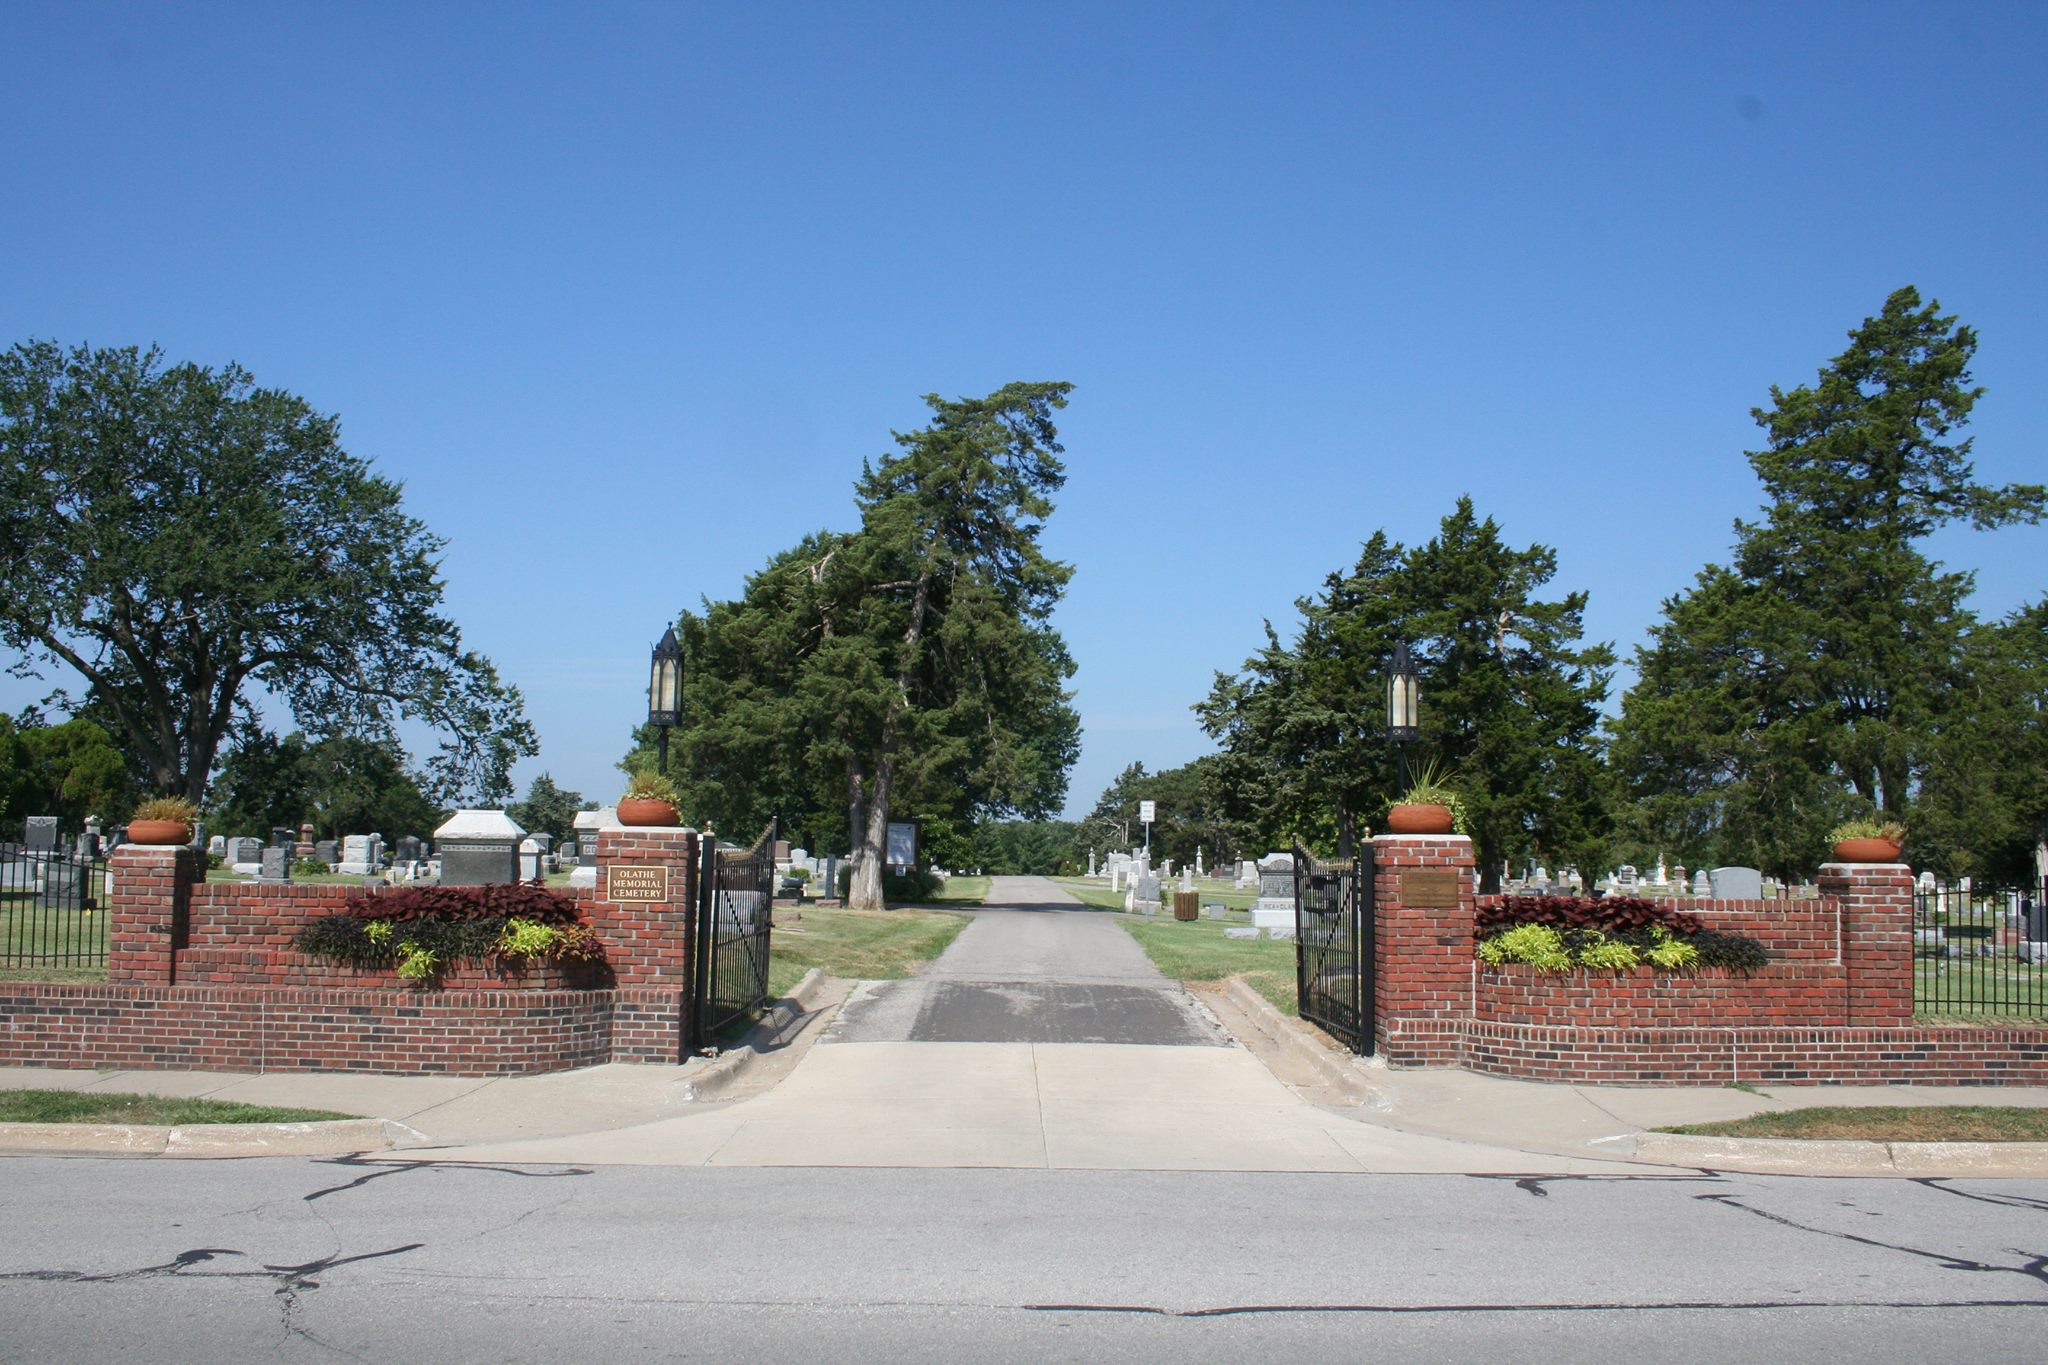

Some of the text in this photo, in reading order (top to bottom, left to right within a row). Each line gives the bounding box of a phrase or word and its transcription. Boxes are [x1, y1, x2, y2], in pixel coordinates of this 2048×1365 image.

[620, 870, 656, 879] OLATHE
[613, 880, 662, 888] MEMORIAL
[613, 889, 662, 897] CEMETERY
